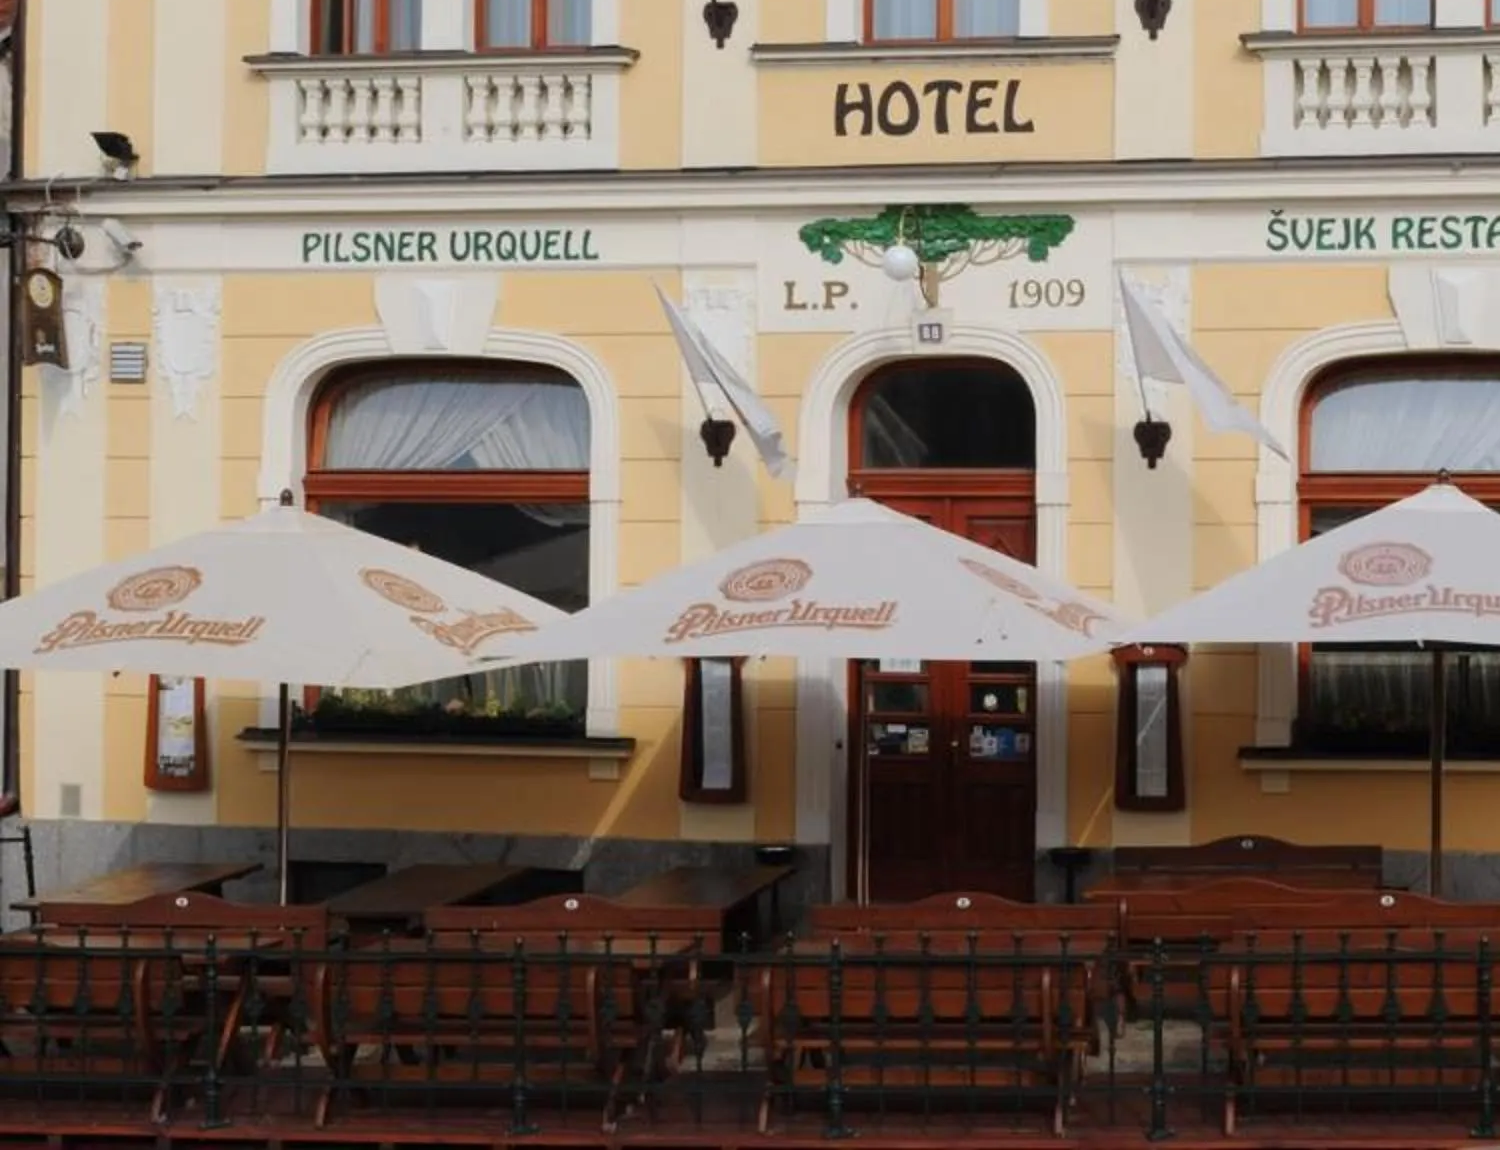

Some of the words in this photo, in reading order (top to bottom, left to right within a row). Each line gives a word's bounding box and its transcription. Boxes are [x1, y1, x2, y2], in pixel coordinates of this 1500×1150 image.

[834, 79, 1035, 137] HOTEL
[302, 230, 439, 263] PILSNER
[449, 229, 600, 263] URQUELL
[1266, 209, 1377, 252] ŠVEJK
[783, 280, 859, 310] L.P.
[1008, 278, 1086, 309] 1909
[664, 602, 791, 644] Pilsner
[788, 600, 898, 630] Urquell
[1309, 586, 1428, 628] Pilsner
[32, 610, 162, 654] Pilsner
[159, 610, 266, 646] Urquell
